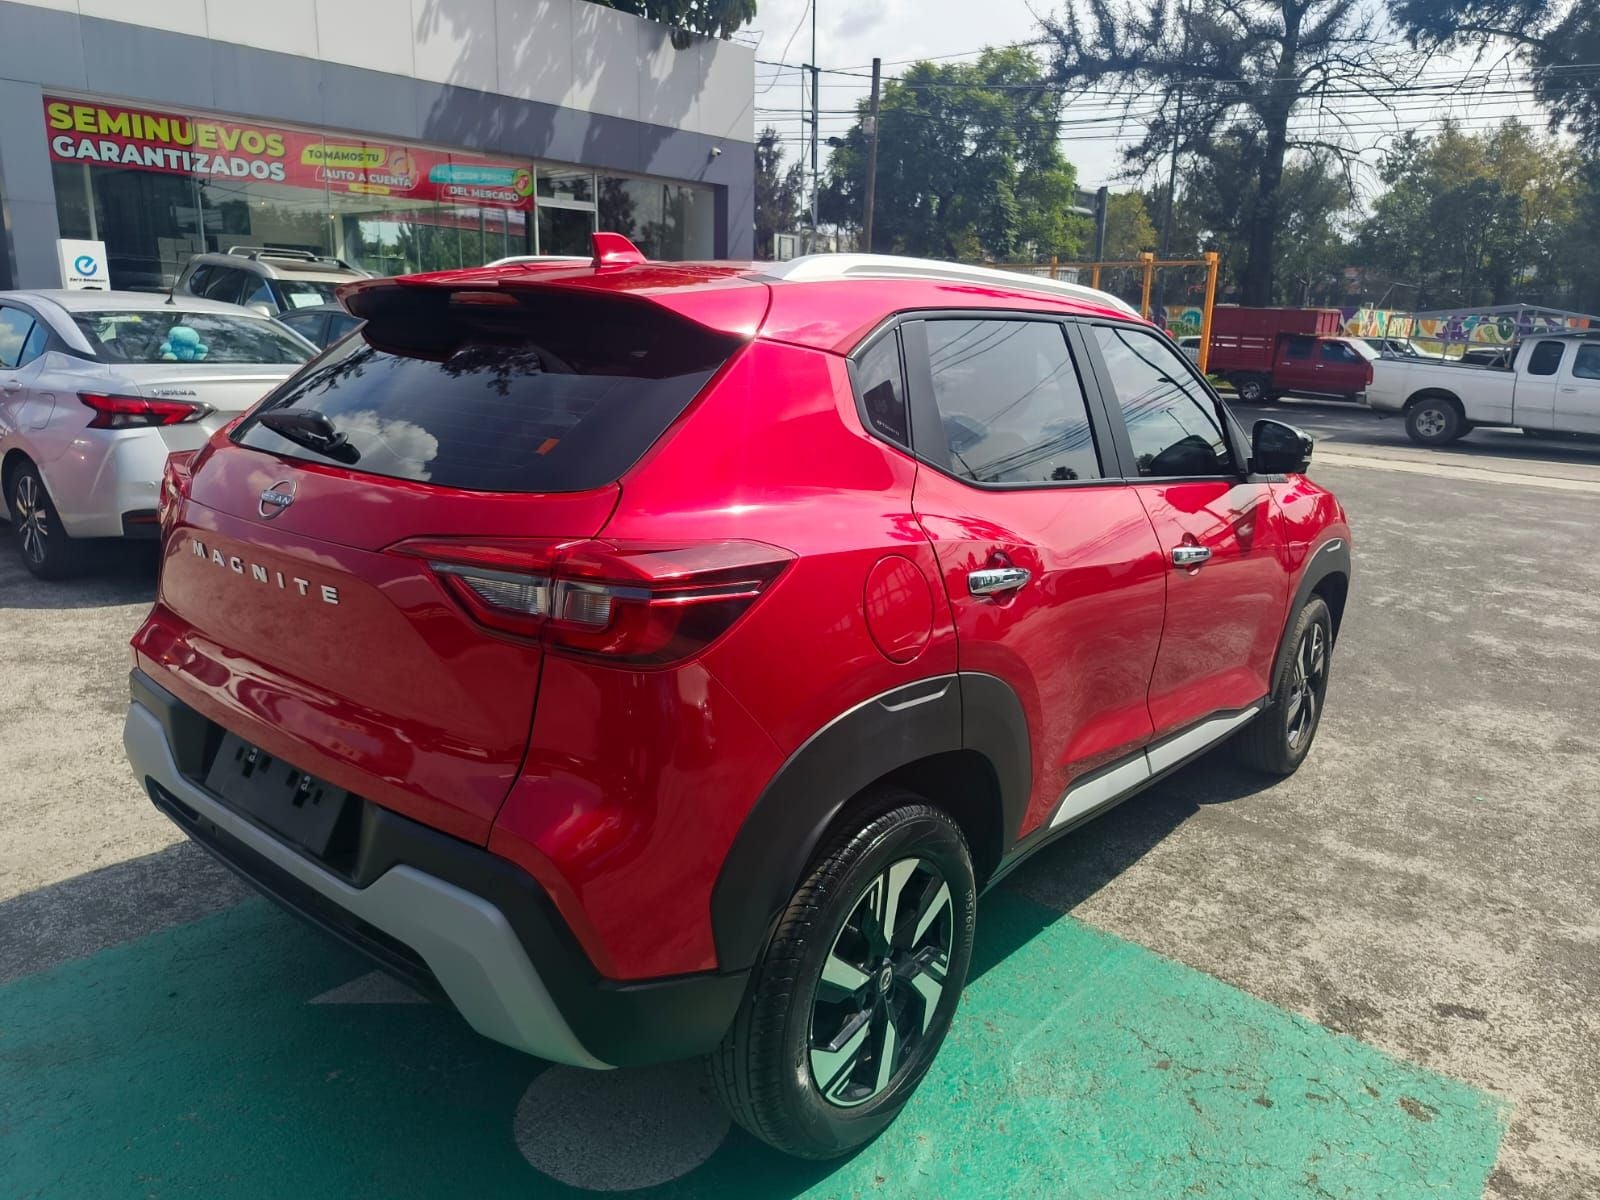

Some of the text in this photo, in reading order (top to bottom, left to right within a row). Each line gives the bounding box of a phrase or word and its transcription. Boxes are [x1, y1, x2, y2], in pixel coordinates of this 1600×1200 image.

[47, 102, 287, 159] SEMINUEVOS
[51, 134, 287, 183] GARANTIZADOS
[307, 149, 380, 163] TOMAMOS TU
[322, 168, 412, 187] AUTO A CUENTA
[449, 185, 519, 202] DEL MERCADO
[192, 539, 339, 605] MAGNITE
